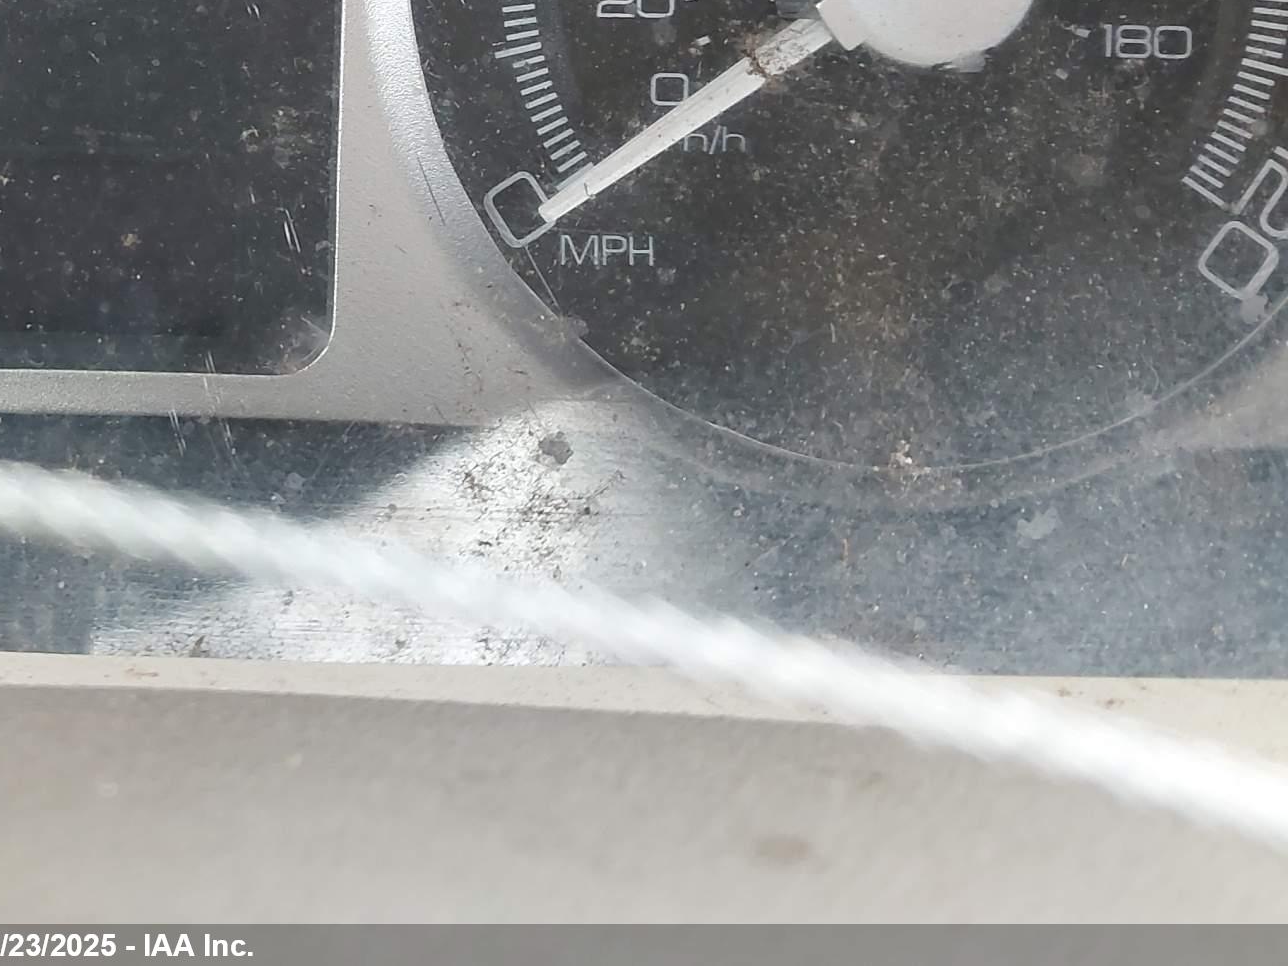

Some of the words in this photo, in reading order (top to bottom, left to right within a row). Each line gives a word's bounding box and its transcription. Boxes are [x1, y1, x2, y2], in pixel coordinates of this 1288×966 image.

[1103, 23, 1193, 60] 180
[650, 72, 690, 107] 0
[483, 170, 560, 248] 0
[1198, 145, 1288, 300] 20
[560, 234, 655, 267] MPH
